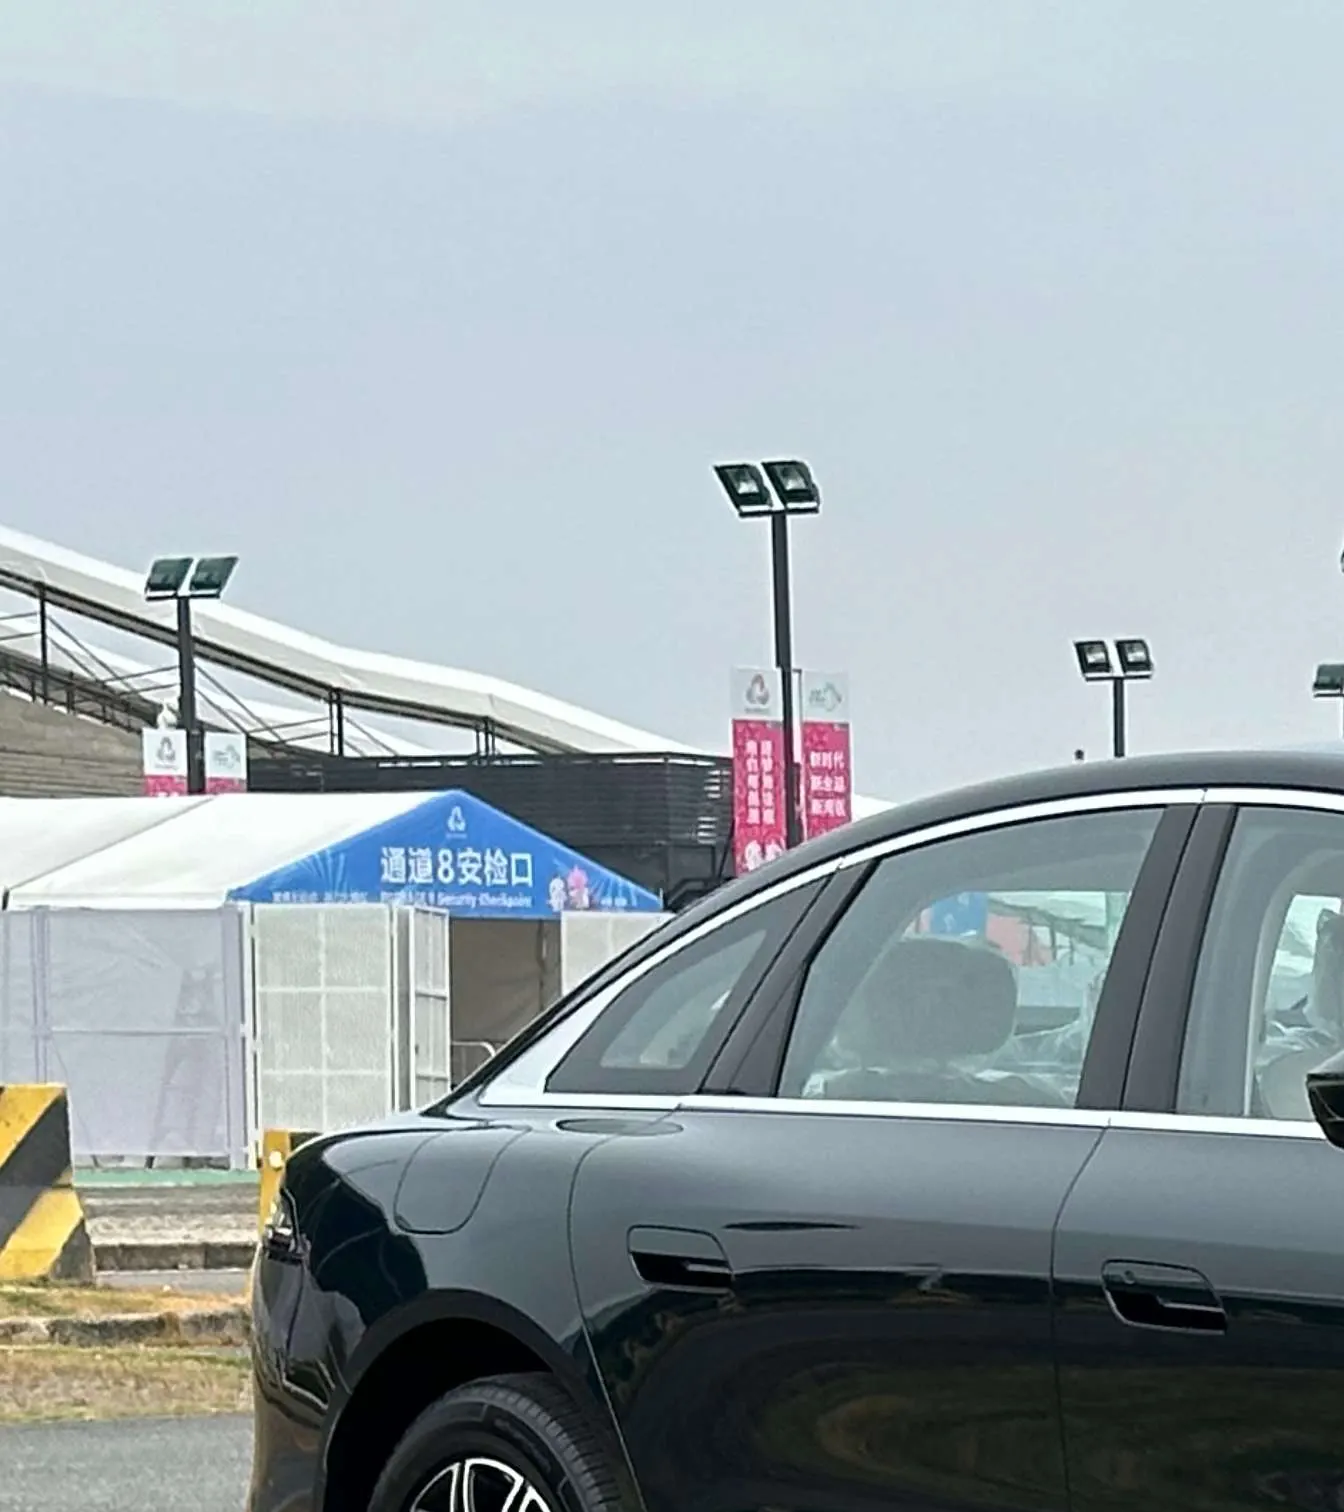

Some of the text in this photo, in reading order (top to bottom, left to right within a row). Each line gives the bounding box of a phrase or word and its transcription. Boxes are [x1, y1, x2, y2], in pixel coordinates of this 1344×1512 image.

[381, 846, 533, 888] 通道8安检口
